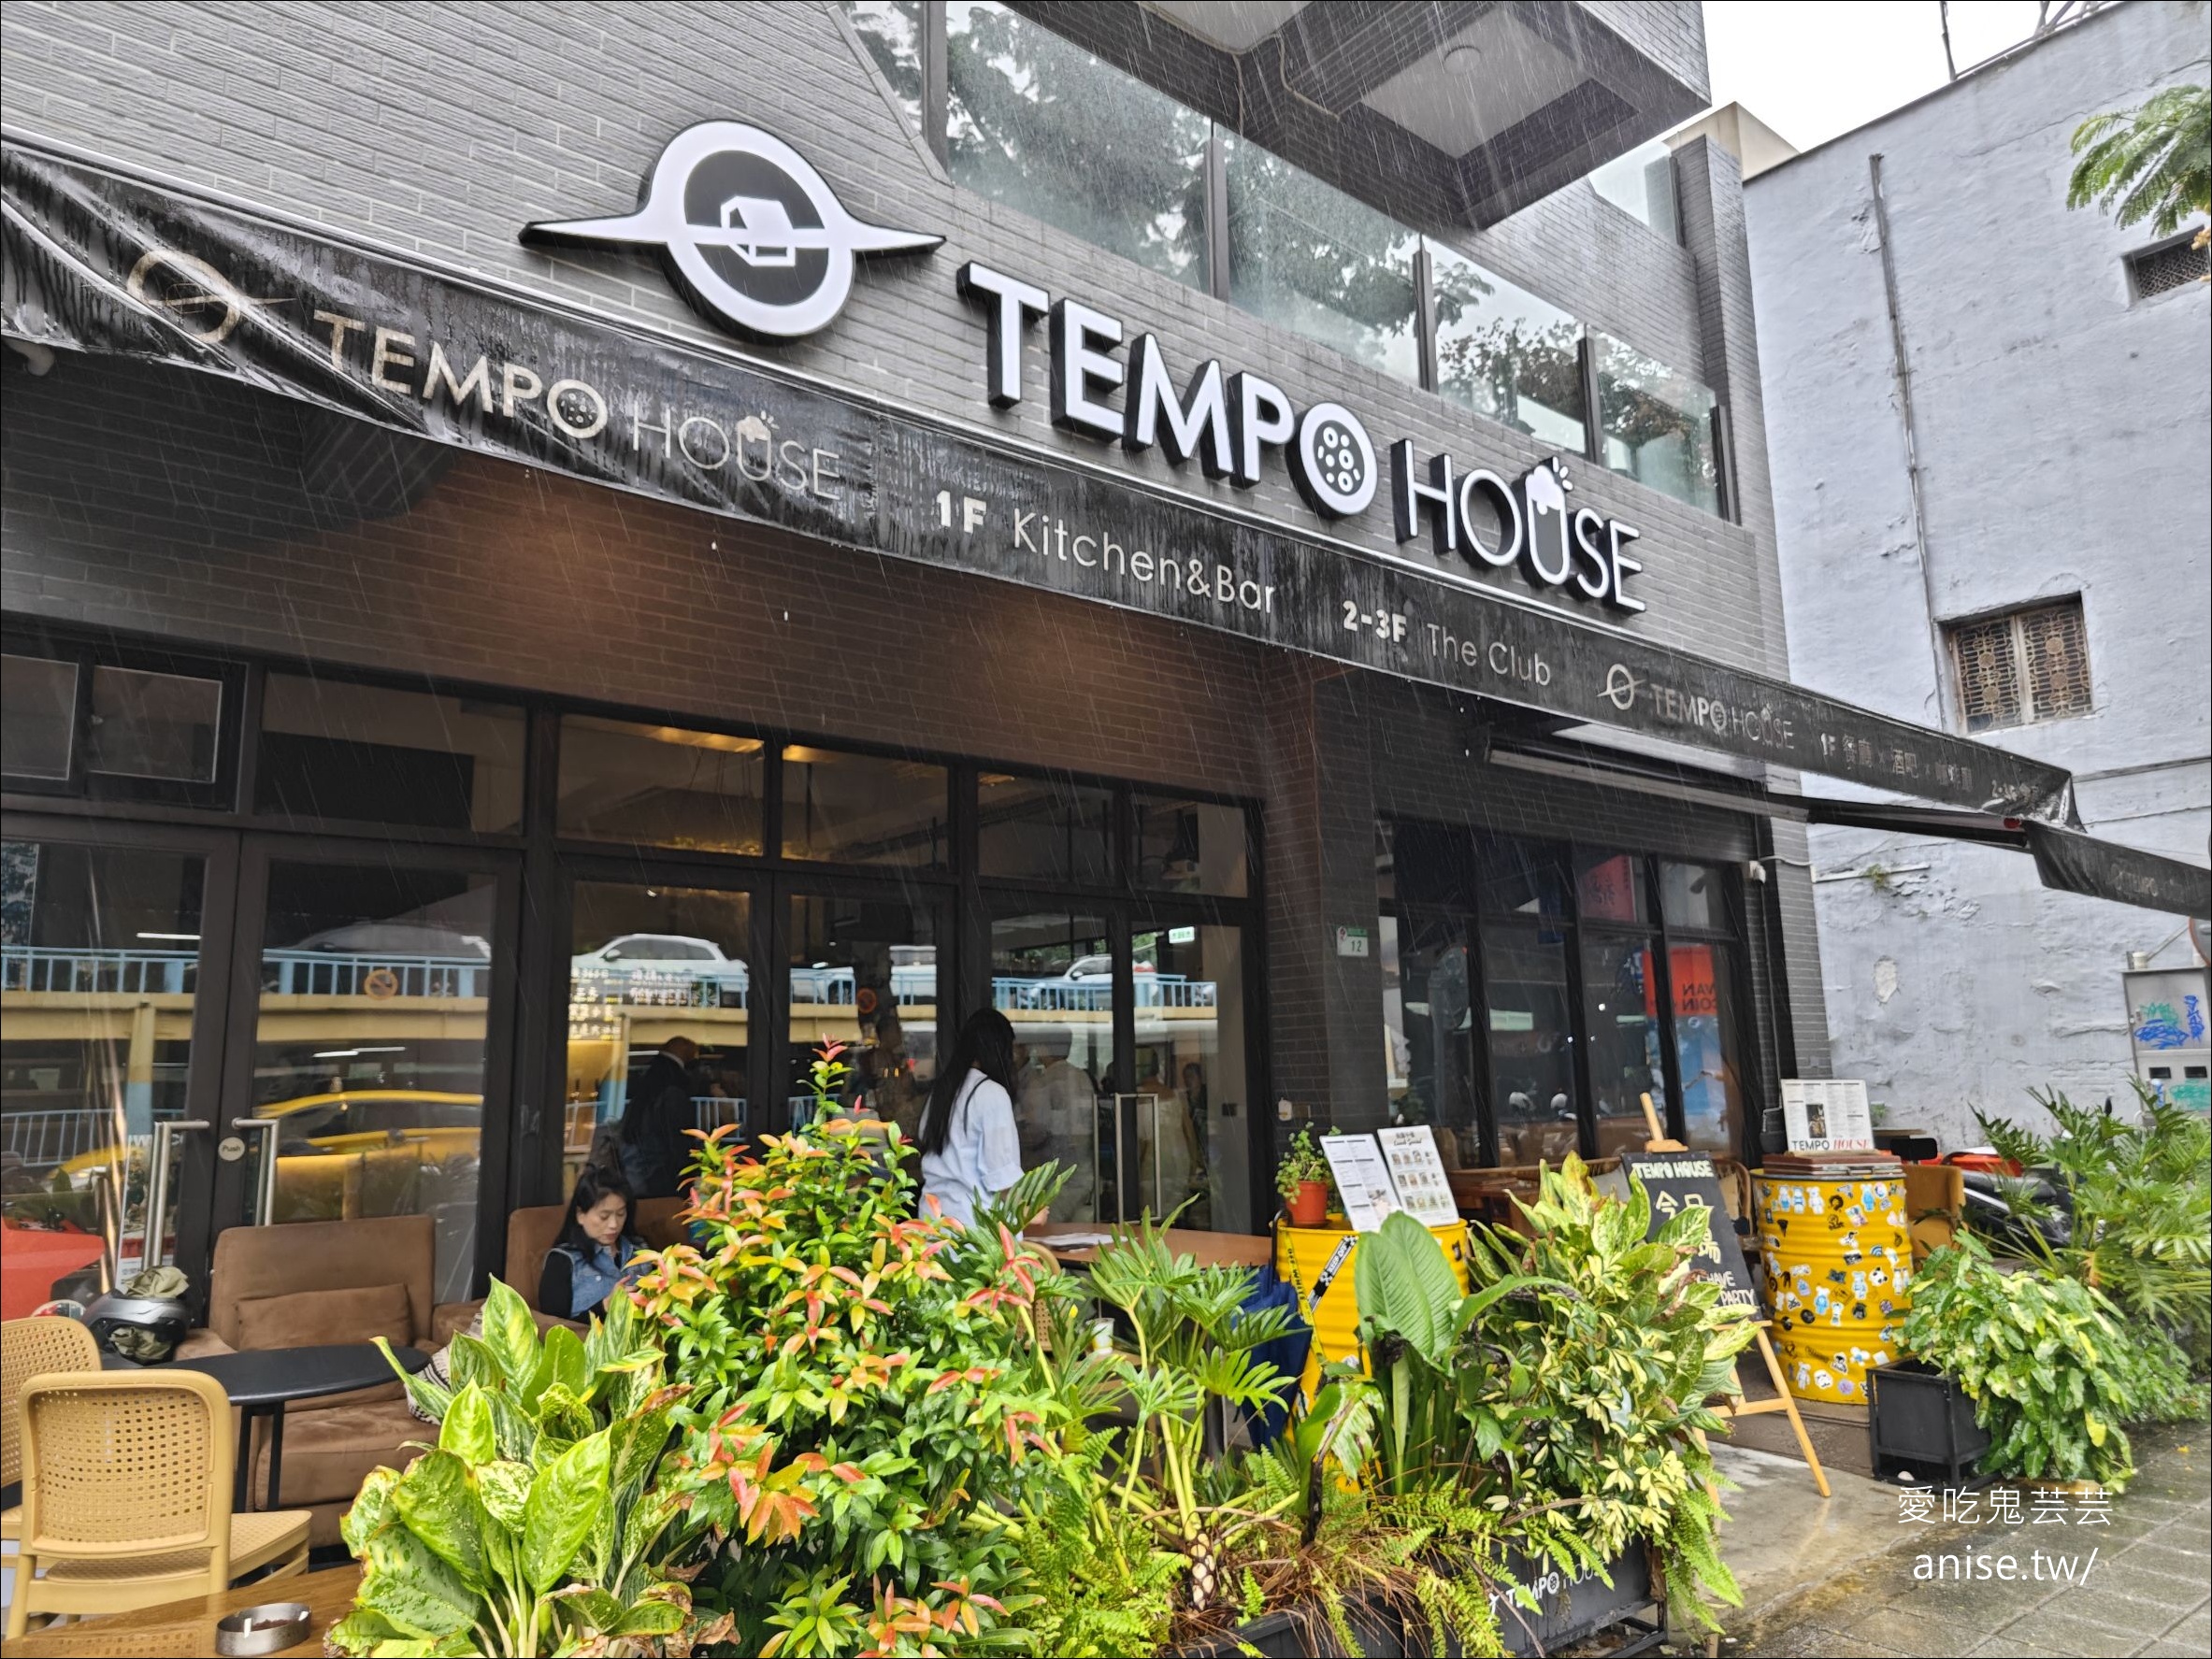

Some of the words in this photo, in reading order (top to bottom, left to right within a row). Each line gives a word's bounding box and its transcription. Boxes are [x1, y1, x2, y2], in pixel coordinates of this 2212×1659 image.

[313, 308, 608, 438] TEMPO
[632, 402, 842, 501] HOUSE
[963, 262, 1378, 516] TEMPO
[1399, 439, 1646, 612] HOUSE
[936, 490, 987, 534] 1F
[1014, 508, 1275, 613] Kitchen&Bar
[1343, 600, 1406, 643] 2-3F
[1428, 623, 1477, 666] The
[1488, 641, 1551, 685] Club
[1650, 683, 1727, 729] TEMPO
[1731, 704, 1794, 749] HOUSE
[1351, 939, 1362, 952] 12
[1631, 1162, 1674, 1179] TEMPO
[1673, 1160, 1715, 1178] HOUSE
[1792, 1140, 1830, 1151] TEMPO
[1720, 1288, 1756, 1307] PARTY
[1505, 1571, 1559, 1608] TMPO
